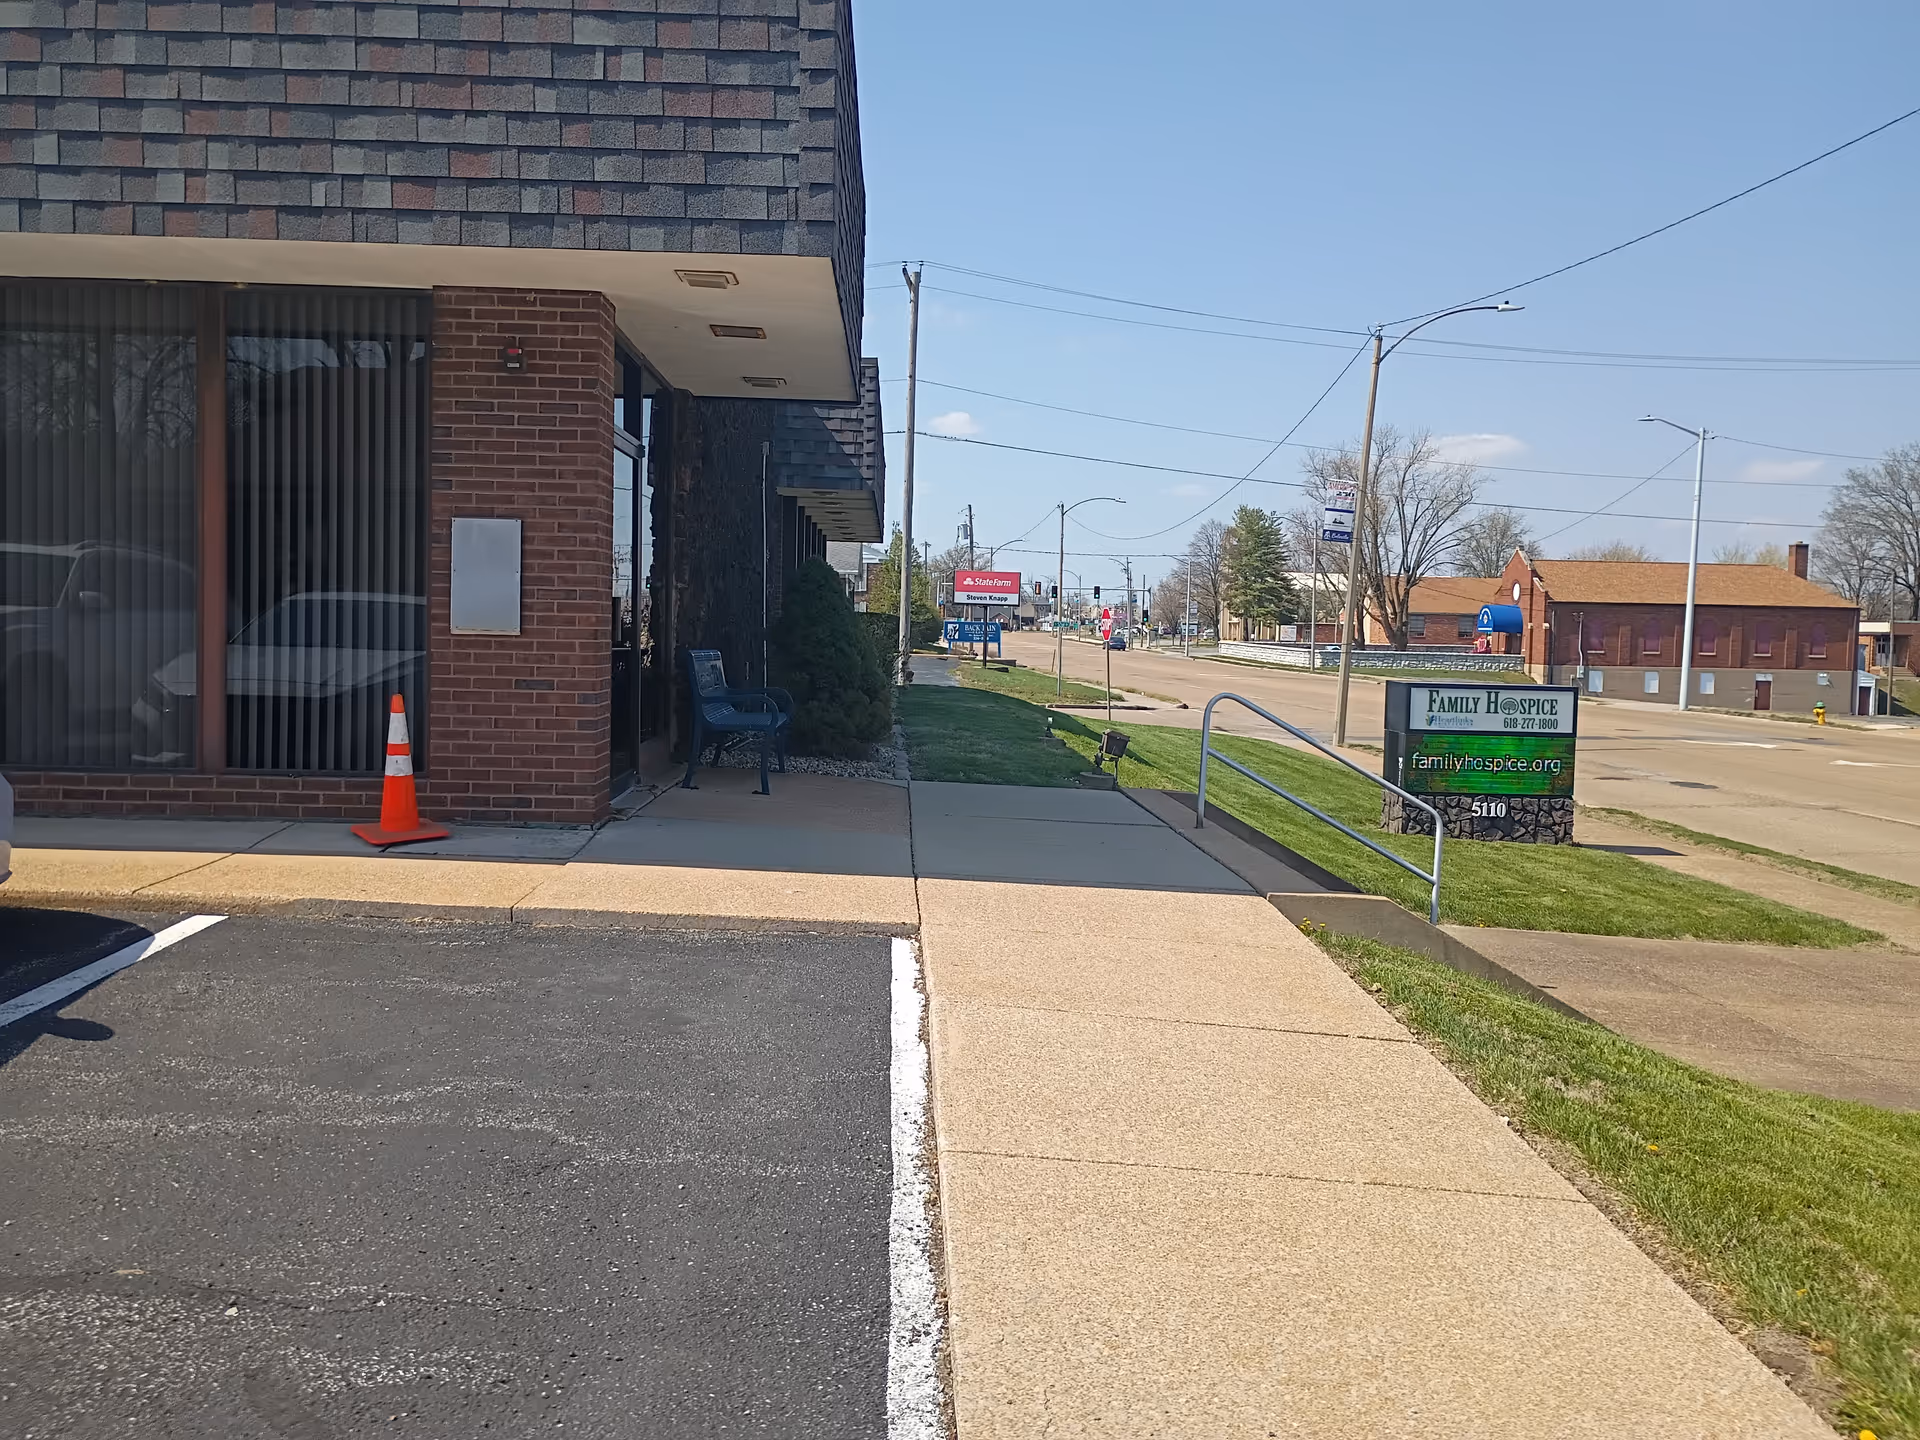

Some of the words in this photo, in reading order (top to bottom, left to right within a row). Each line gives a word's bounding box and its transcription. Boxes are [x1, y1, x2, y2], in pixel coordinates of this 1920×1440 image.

[988, 595, 1009, 603] Knapp
[1427, 689, 1481, 714] FAMILY
[1503, 717, 1559, 730] 618-277-1800
[1411, 752, 1562, 776] familyhospice.org
[1471, 802, 1507, 818] 5110
